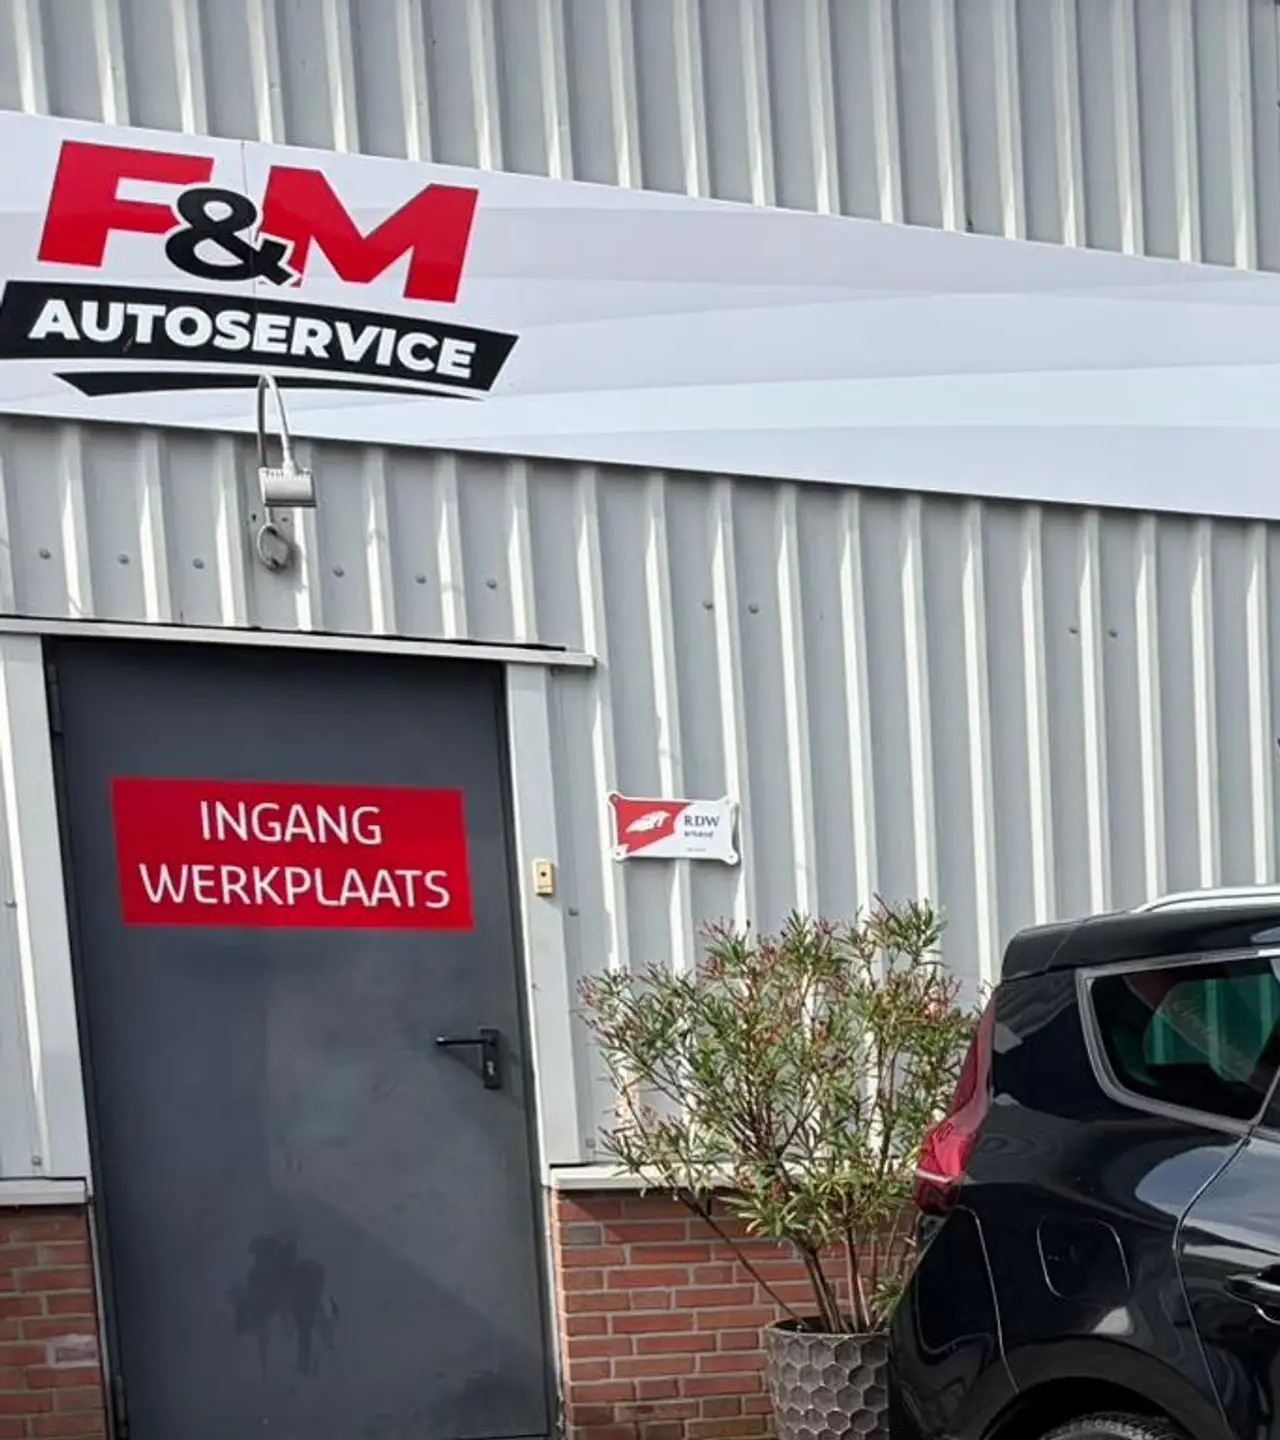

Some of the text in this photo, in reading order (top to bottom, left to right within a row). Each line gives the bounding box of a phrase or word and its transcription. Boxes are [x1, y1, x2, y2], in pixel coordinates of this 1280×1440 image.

[37, 139, 480, 303] F&M
[28, 298, 477, 379] AUTOSERVICE
[200, 800, 382, 845] INGANG
[684, 814, 720, 828] RDW
[138, 863, 451, 909] WERKPLAATS
